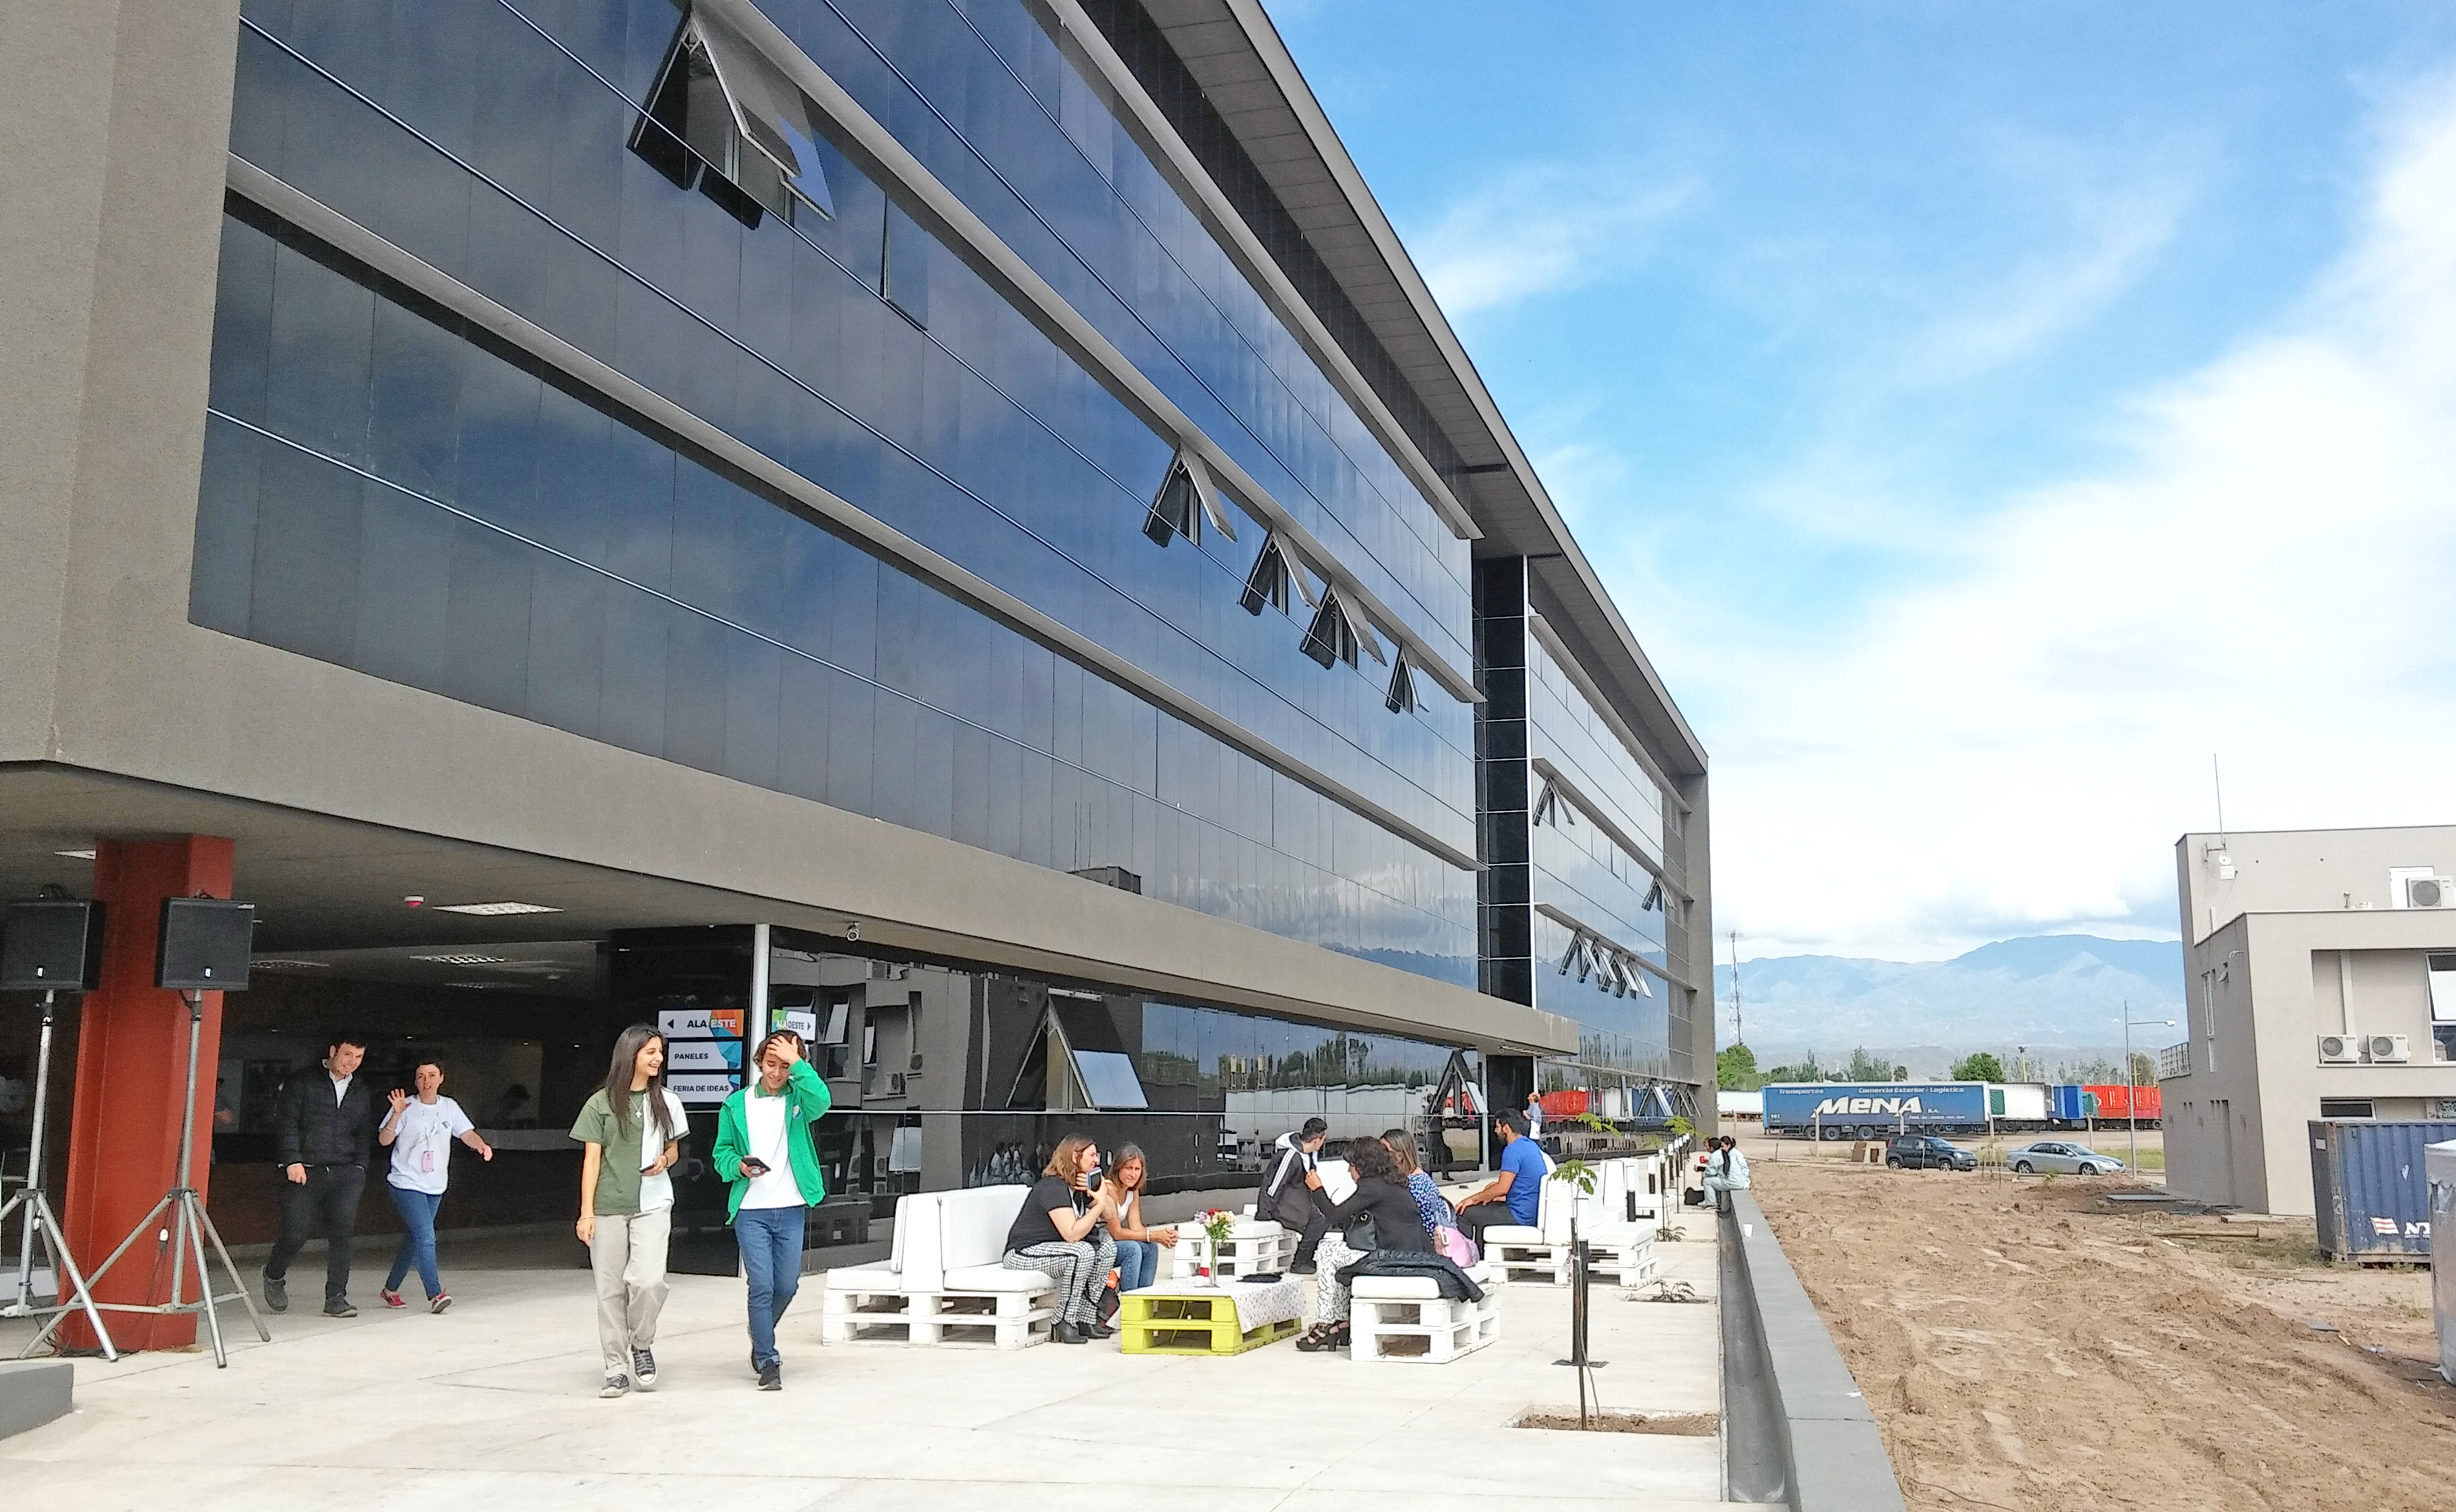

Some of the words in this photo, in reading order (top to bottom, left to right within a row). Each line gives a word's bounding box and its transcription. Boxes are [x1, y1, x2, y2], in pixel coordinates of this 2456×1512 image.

[686, 1019, 708, 1028] ALA
[711, 1019, 737, 1028] ESTE
[776, 1019, 787, 1029] ALA
[788, 1021, 805, 1030] OESTE
